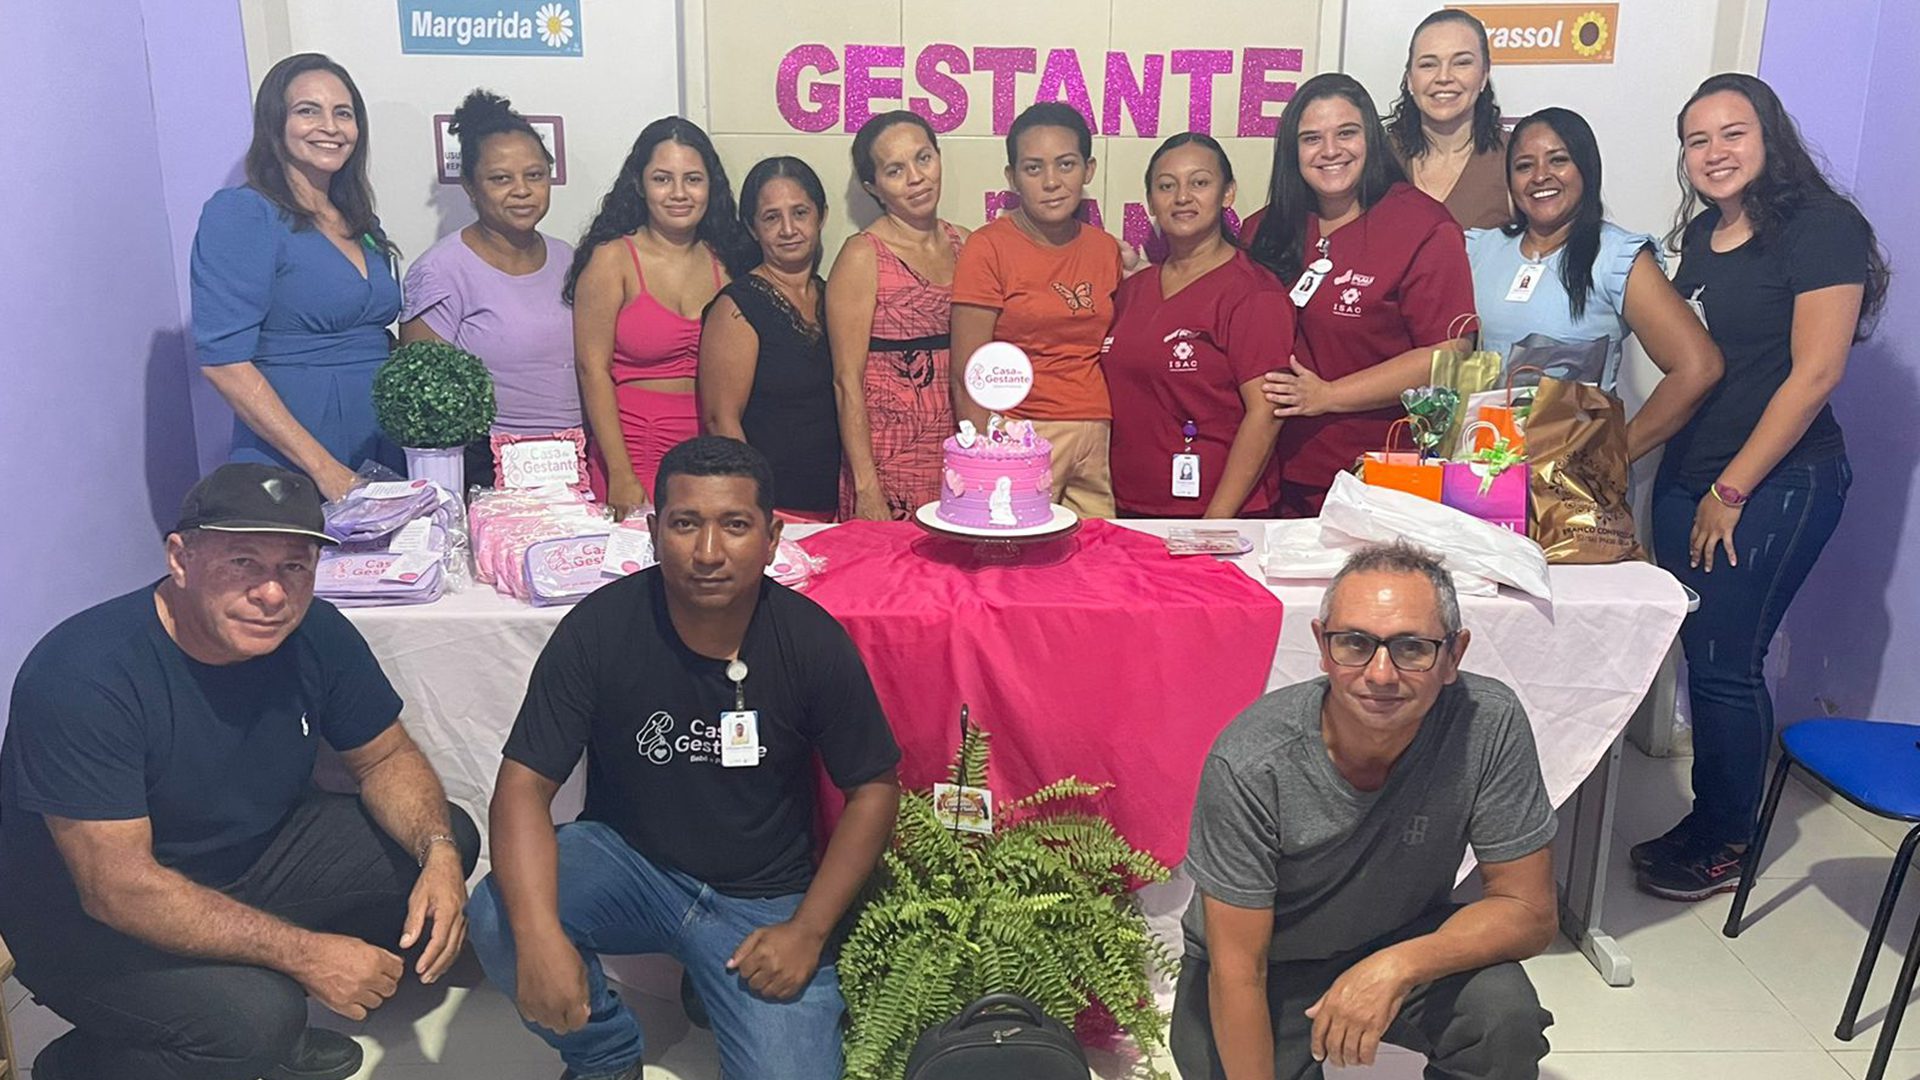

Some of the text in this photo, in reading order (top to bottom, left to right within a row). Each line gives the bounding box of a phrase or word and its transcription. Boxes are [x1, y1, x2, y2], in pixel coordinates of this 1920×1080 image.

[411, 11, 532, 45] Margarida
[1483, 20, 1564, 48] rassol
[776, 44, 1303, 137] GESTANTE
[1333, 303, 1361, 313] ISAC
[1169, 360, 1198, 368] ISAC
[992, 366, 1016, 375] Casa
[985, 374, 1031, 384] Gestante
[530, 447, 561, 460] Casa
[365, 559, 391, 569] Cas
[352, 568, 386, 576] Gest
[690, 719, 722, 739] Ca
[674, 735, 768, 758] Geste
